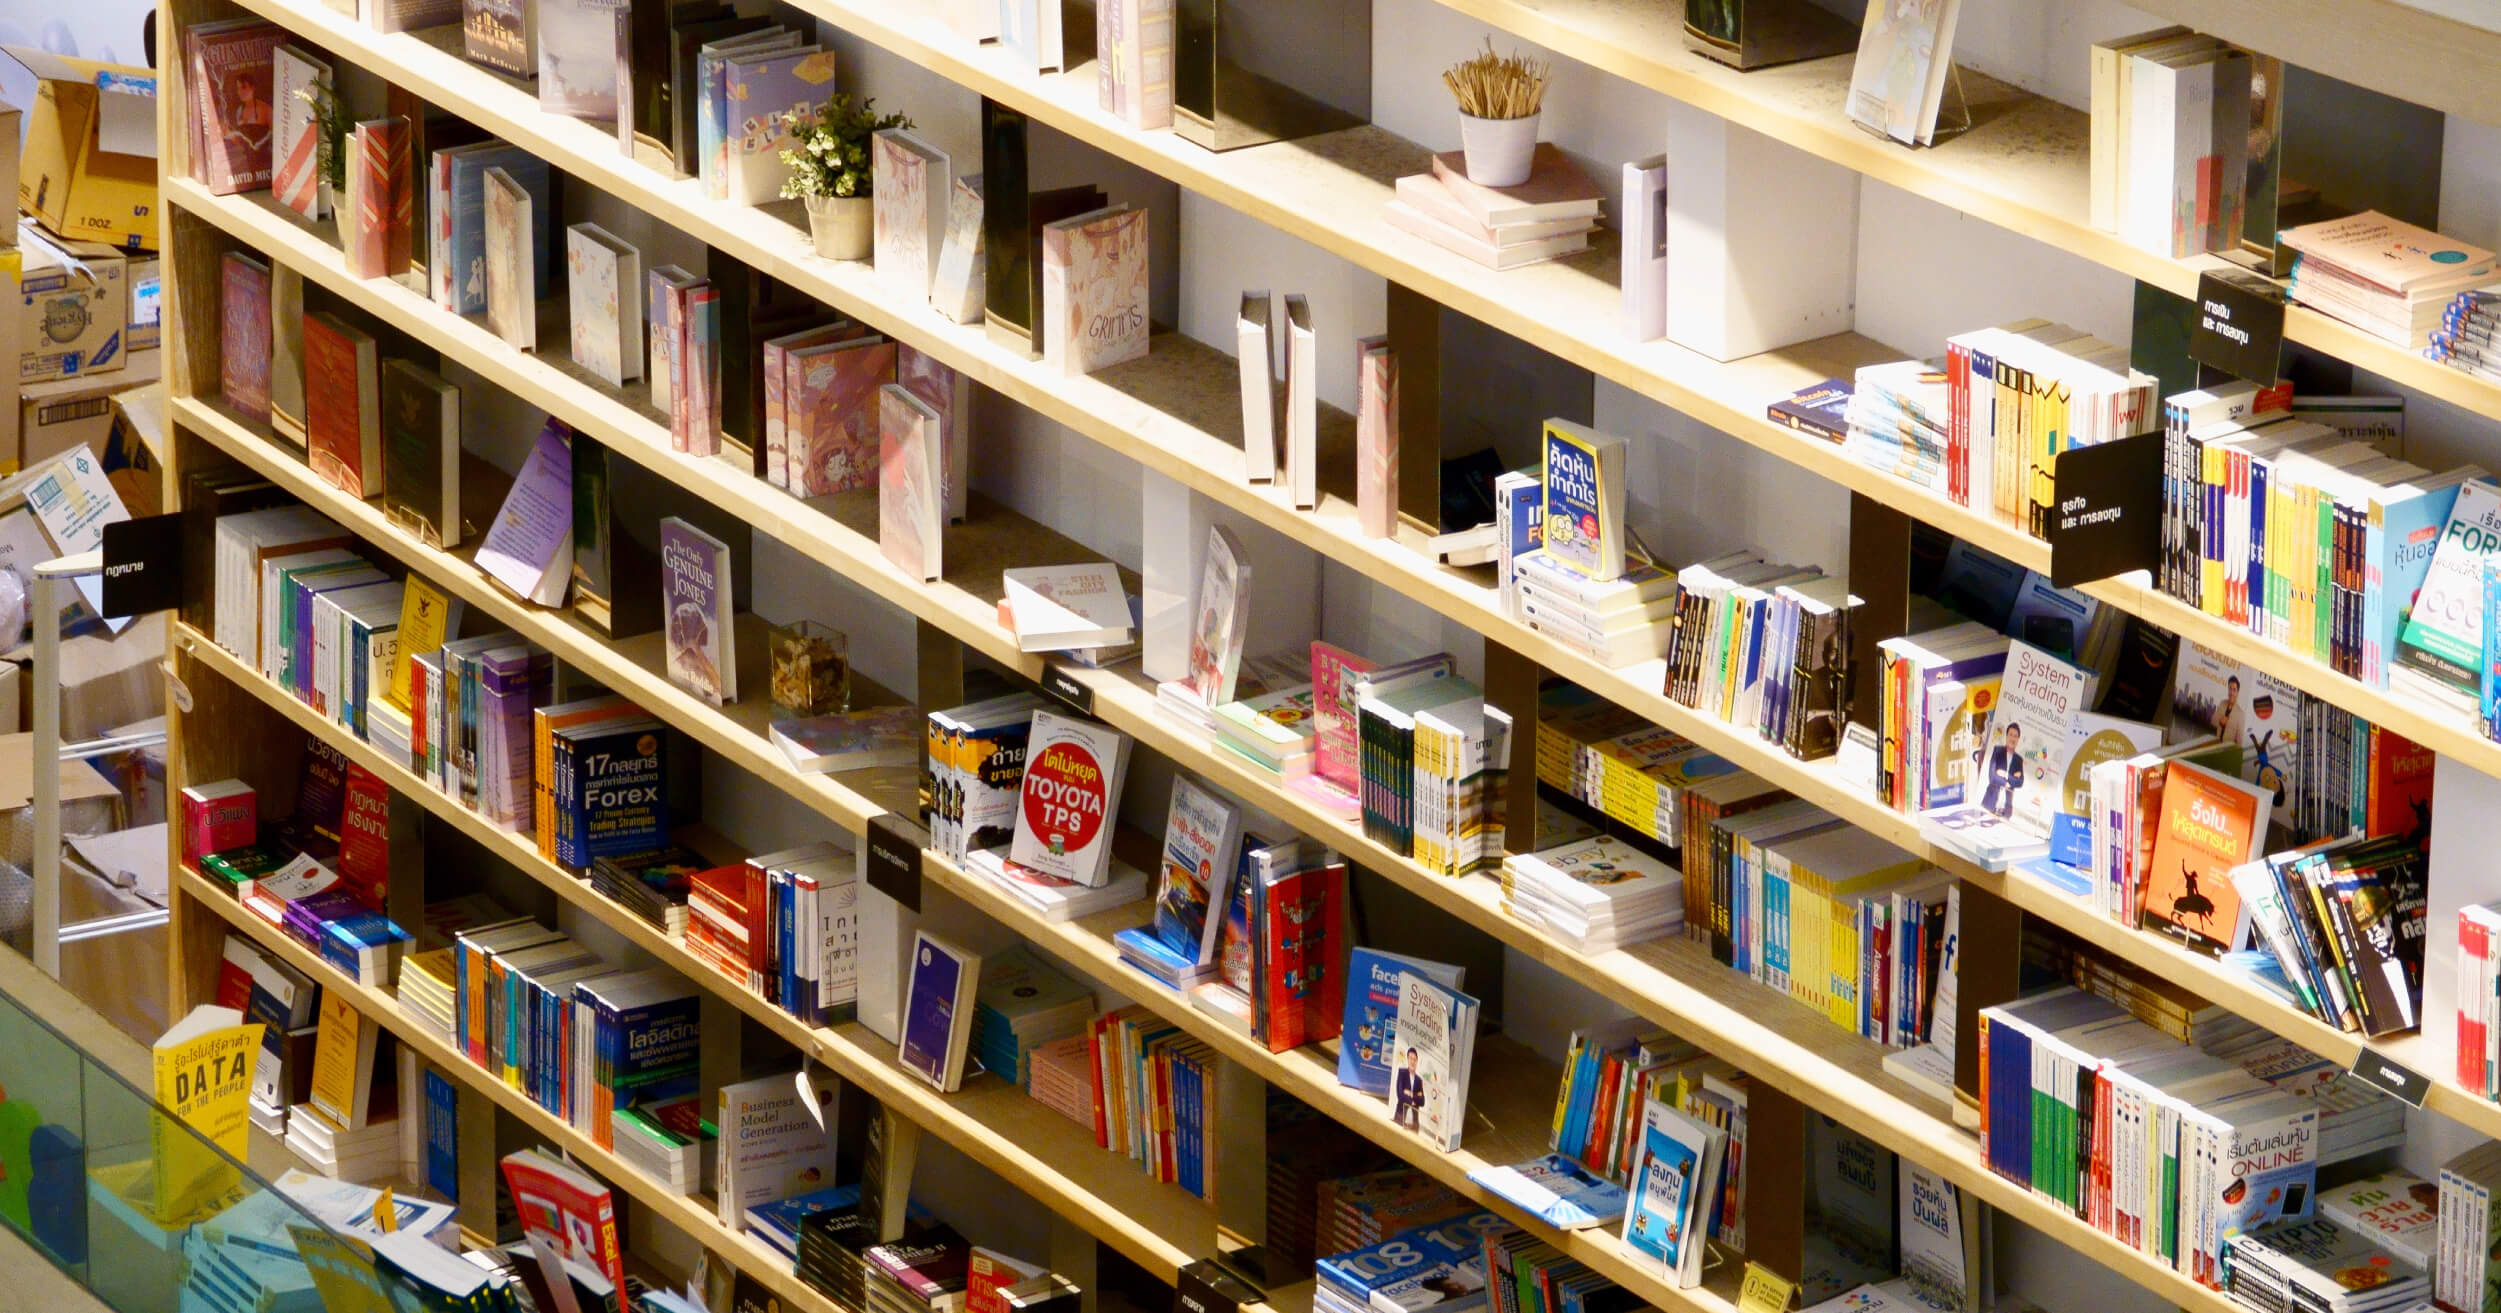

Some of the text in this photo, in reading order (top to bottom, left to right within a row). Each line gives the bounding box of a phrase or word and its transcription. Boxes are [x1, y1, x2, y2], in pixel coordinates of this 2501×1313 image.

[256, 170, 272, 181] MIC
[1550, 443, 1594, 484] คัดหุ้น
[2061, 507, 2121, 530] และ การลงทุน
[2062, 496, 2086, 515] ธุรกิจ
[672, 538, 685, 555] The
[2446, 519, 2501, 556] FOR
[105, 561, 144, 577] กฎหมาย
[663, 545, 714, 591] GENUINE
[673, 571, 706, 606] JONES
[2020, 651, 2070, 689] System
[2017, 671, 2067, 714] Trading
[1043, 748, 1097, 785] โตไม่หยุด
[585, 786, 658, 811] Forex
[1028, 774, 1101, 816] TOYOTA
[590, 815, 656, 833] Trading Strategies
[1043, 803, 1082, 832] TPS
[1370, 982, 1384, 993] ads
[1410, 983, 1443, 1018] System
[1410, 1001, 1443, 1041] Trading
[176, 1051, 246, 1104] DATA
[176, 1079, 245, 1117] FOR THE PEOPLE
[741, 1097, 795, 1113] Business
[740, 1121, 809, 1139] Generation
[741, 1110, 779, 1127] Model
[2227, 1126, 2310, 1161] เริ่มต้นเล่นหุ้น
[1652, 1162, 1681, 1193] ลงทุน
[2231, 1147, 2304, 1177] ONLINE
[603, 1220, 617, 1263] Excel
[1332, 1241, 1424, 1281] 108
[1378, 1262, 1451, 1297] facebook
